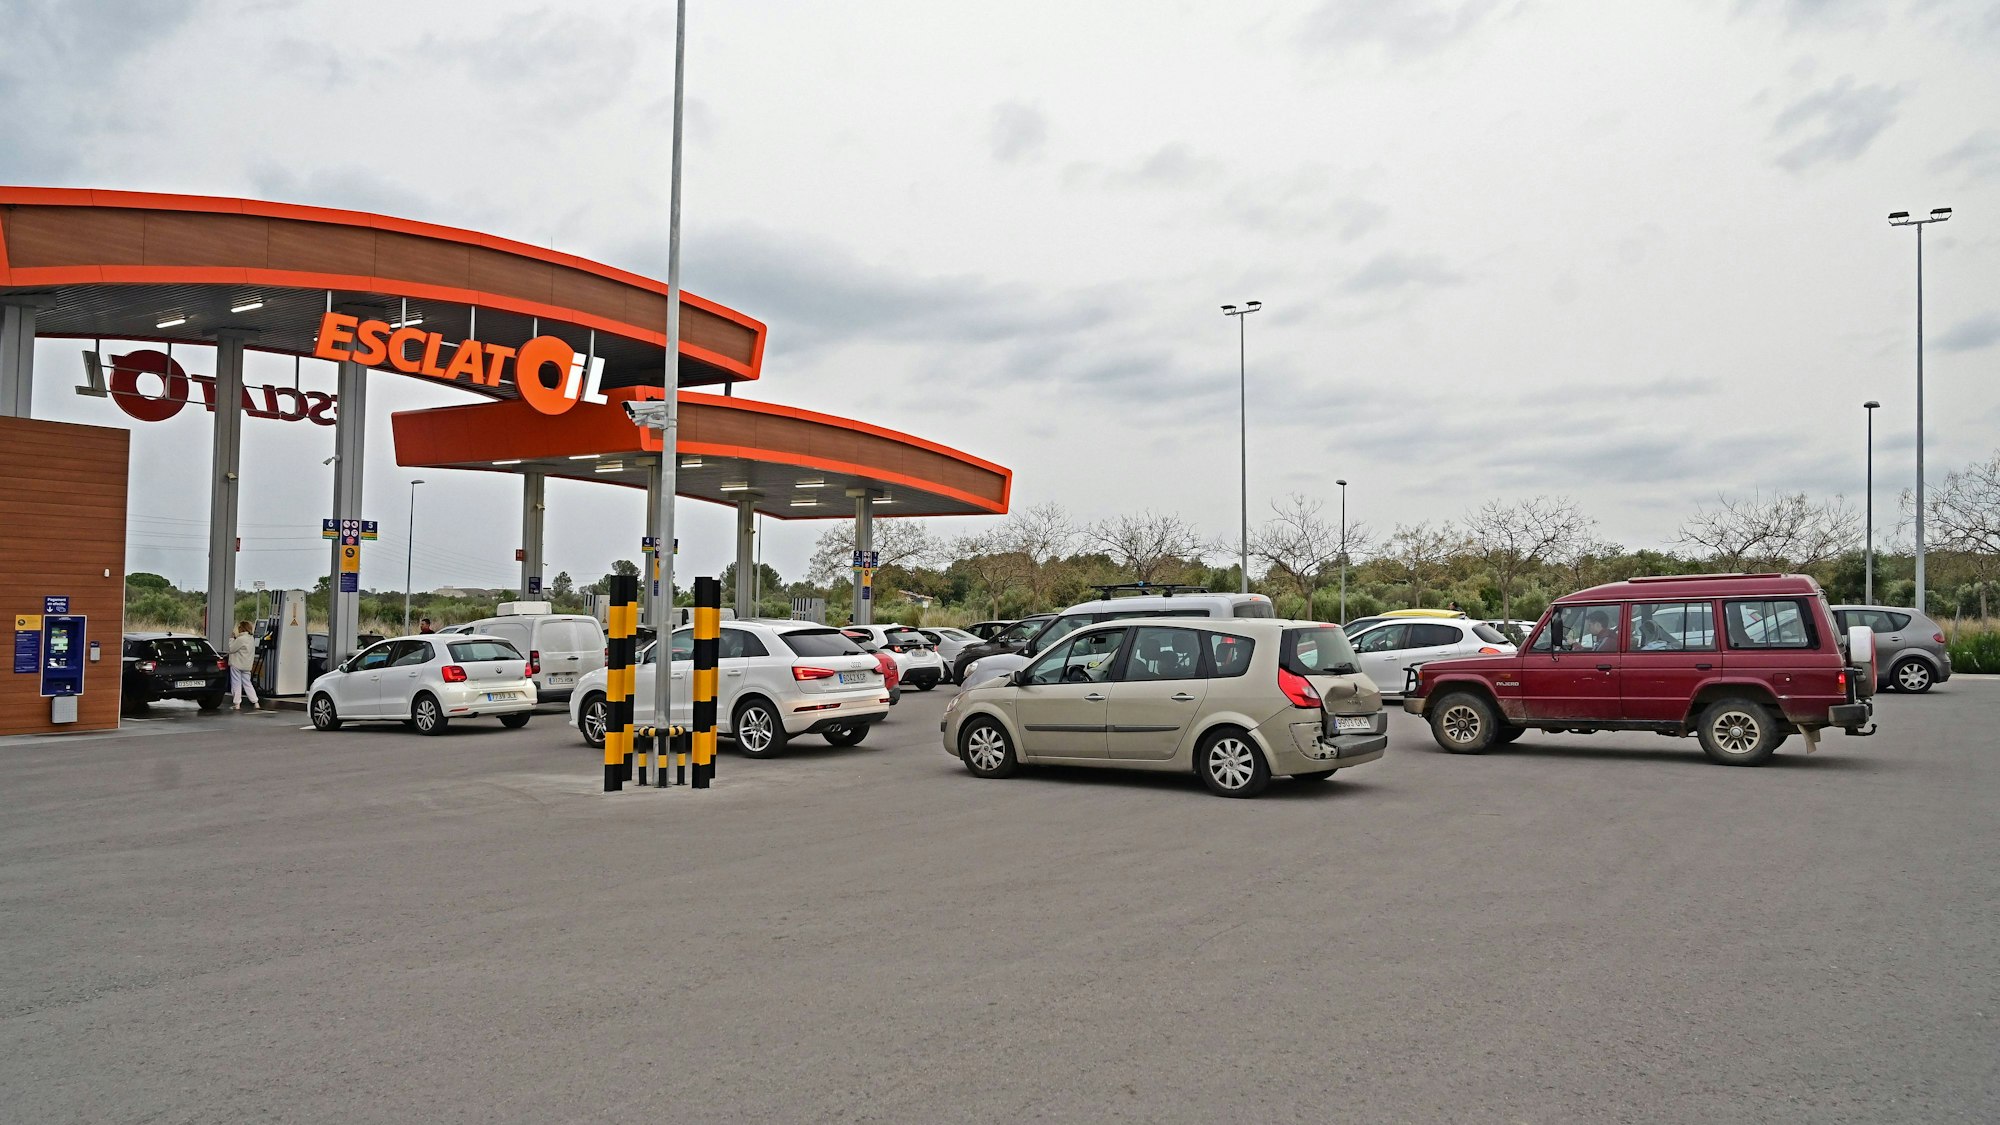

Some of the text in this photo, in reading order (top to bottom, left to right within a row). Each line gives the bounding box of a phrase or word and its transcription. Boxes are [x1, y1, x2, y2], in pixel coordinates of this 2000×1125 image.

[313, 312, 516, 387] ESCLAT
[328, 520, 334, 528] 6
[368, 521, 374, 529] 5
